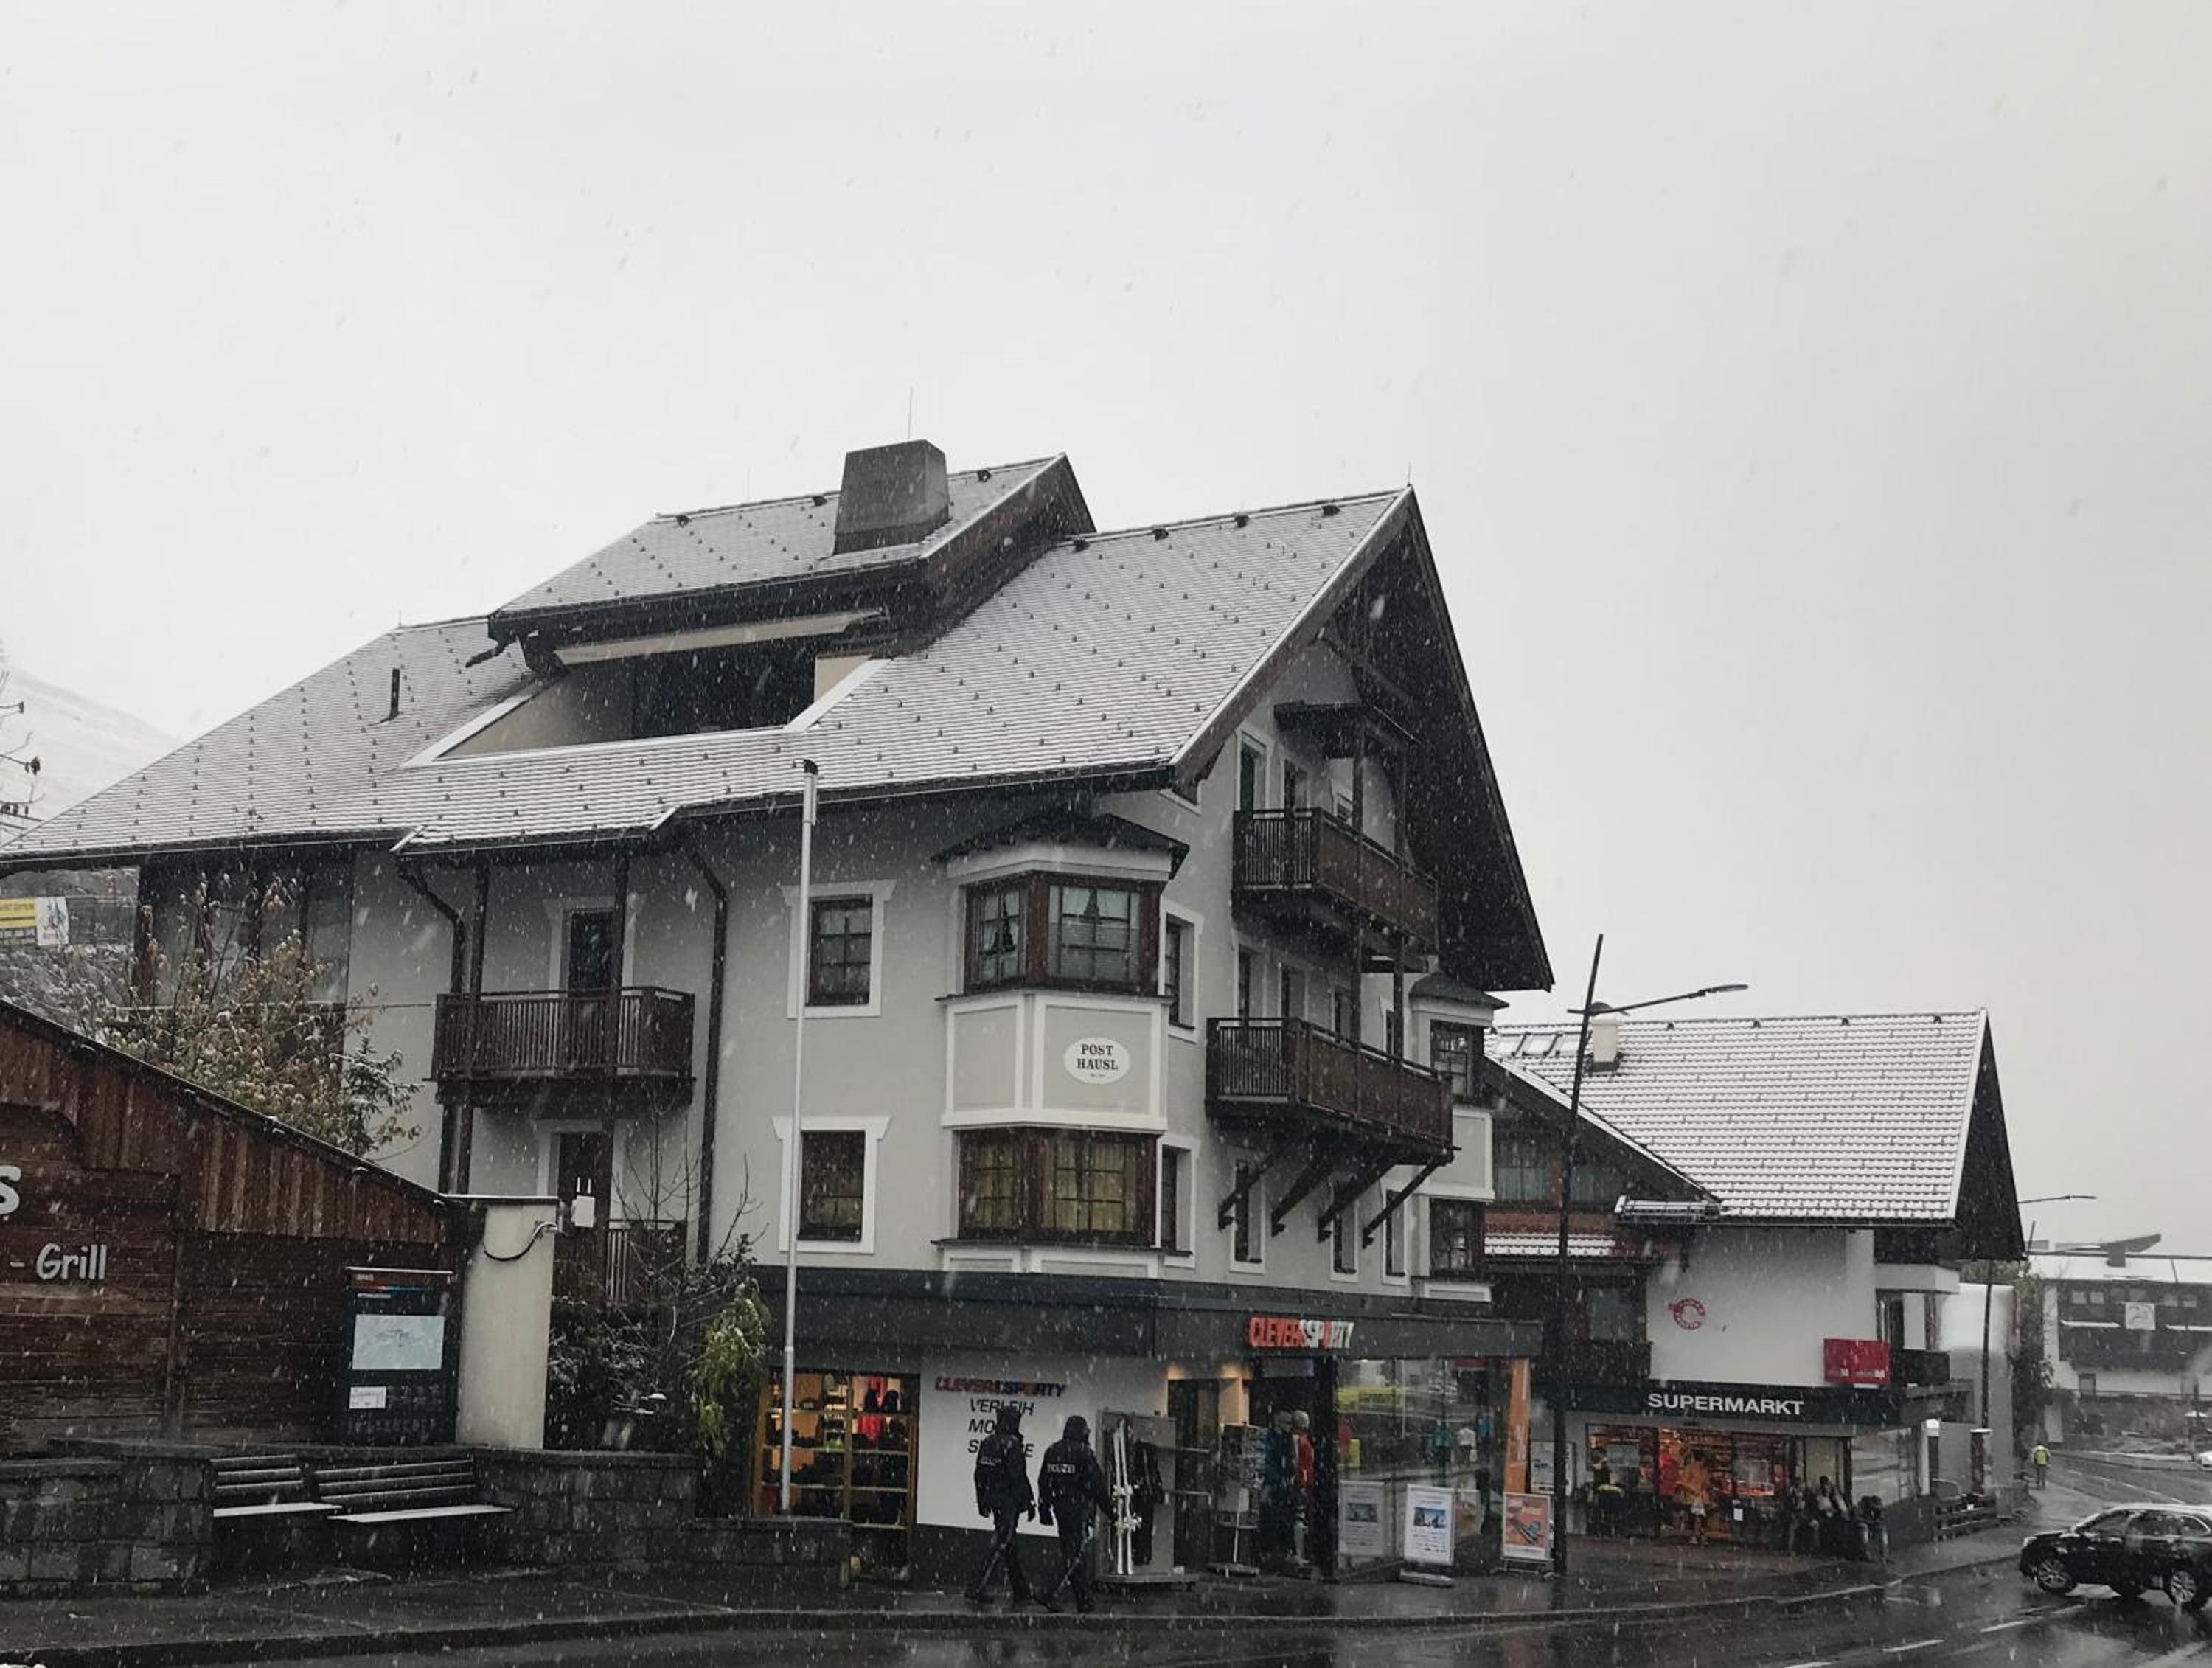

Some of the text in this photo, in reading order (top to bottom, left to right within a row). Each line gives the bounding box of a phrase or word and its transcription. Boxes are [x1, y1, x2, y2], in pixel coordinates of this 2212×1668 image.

[1082, 1044, 1113, 1055] POST
[1077, 1058, 1118, 1070] HAUSL
[37, 1243, 107, 1280] Grill
[1647, 1393, 1804, 1416] SUPERMARKT
